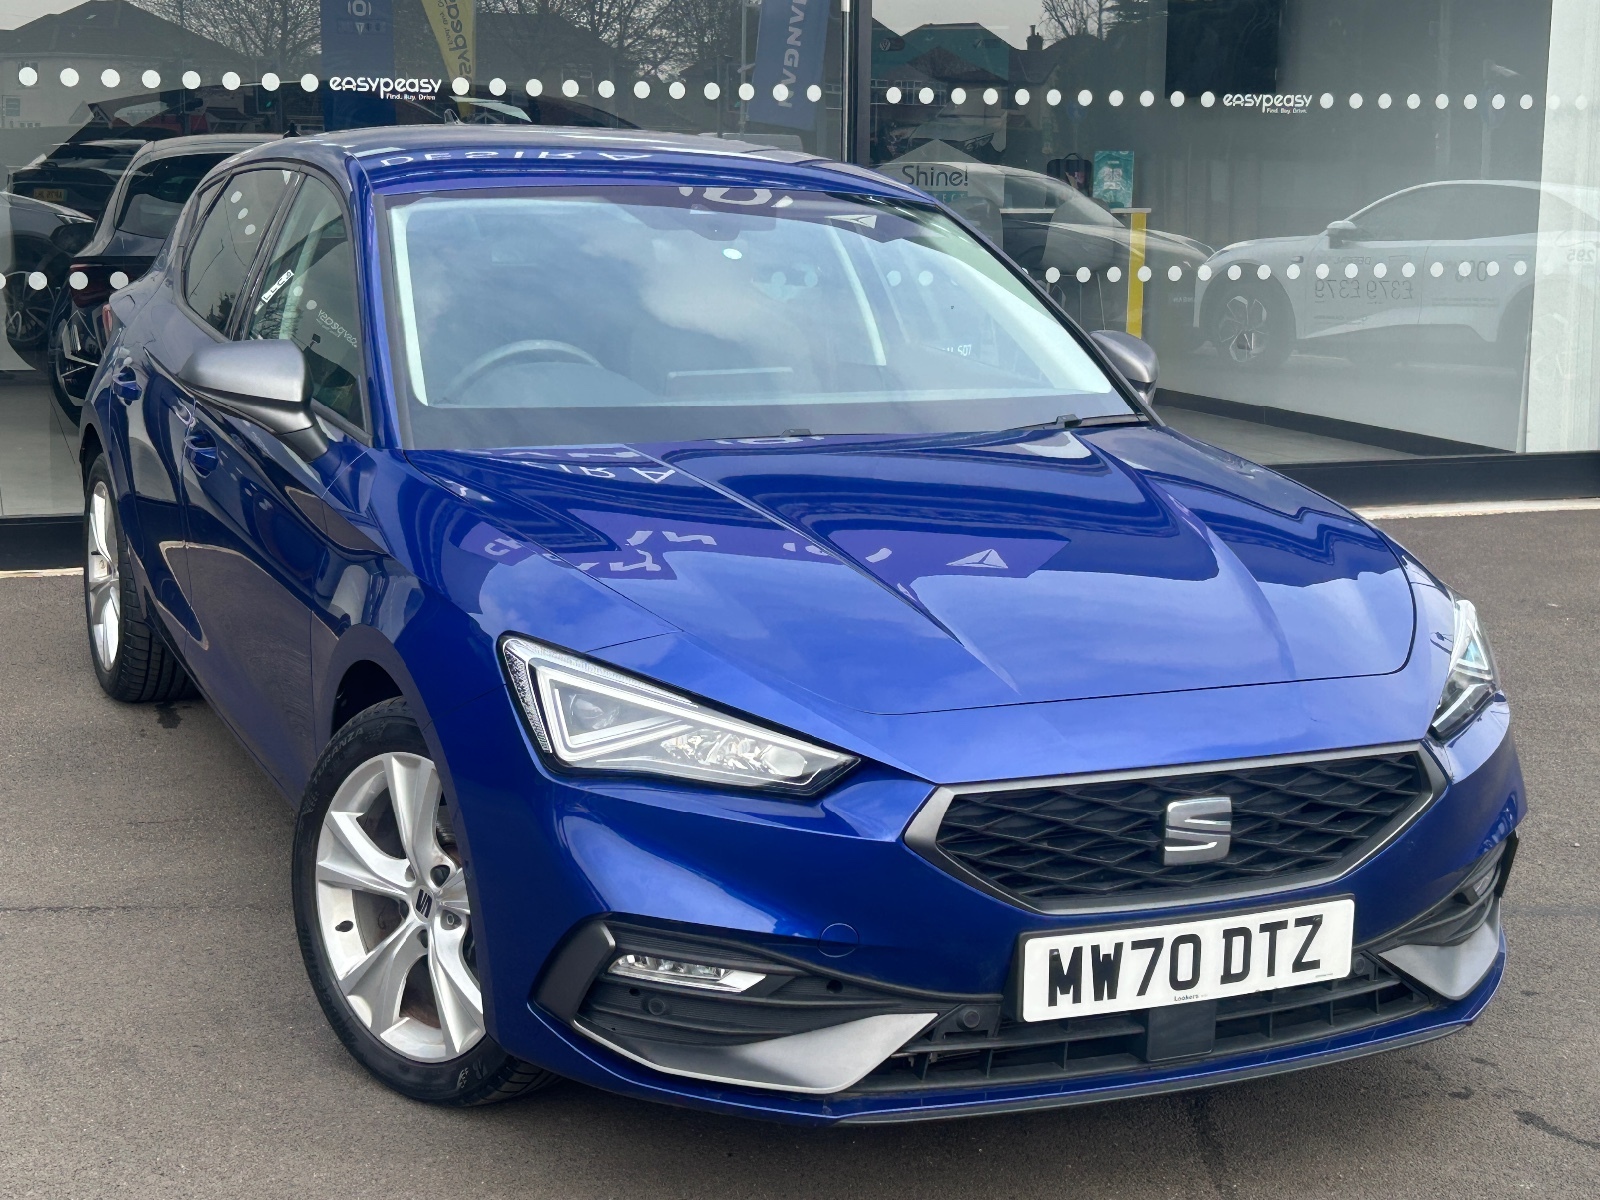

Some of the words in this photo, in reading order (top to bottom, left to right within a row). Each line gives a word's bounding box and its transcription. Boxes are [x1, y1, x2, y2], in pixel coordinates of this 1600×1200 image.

[902, 165, 968, 187] Shine!
[1048, 934, 1202, 1007] MW70
[1220, 914, 1324, 985] DTZ
